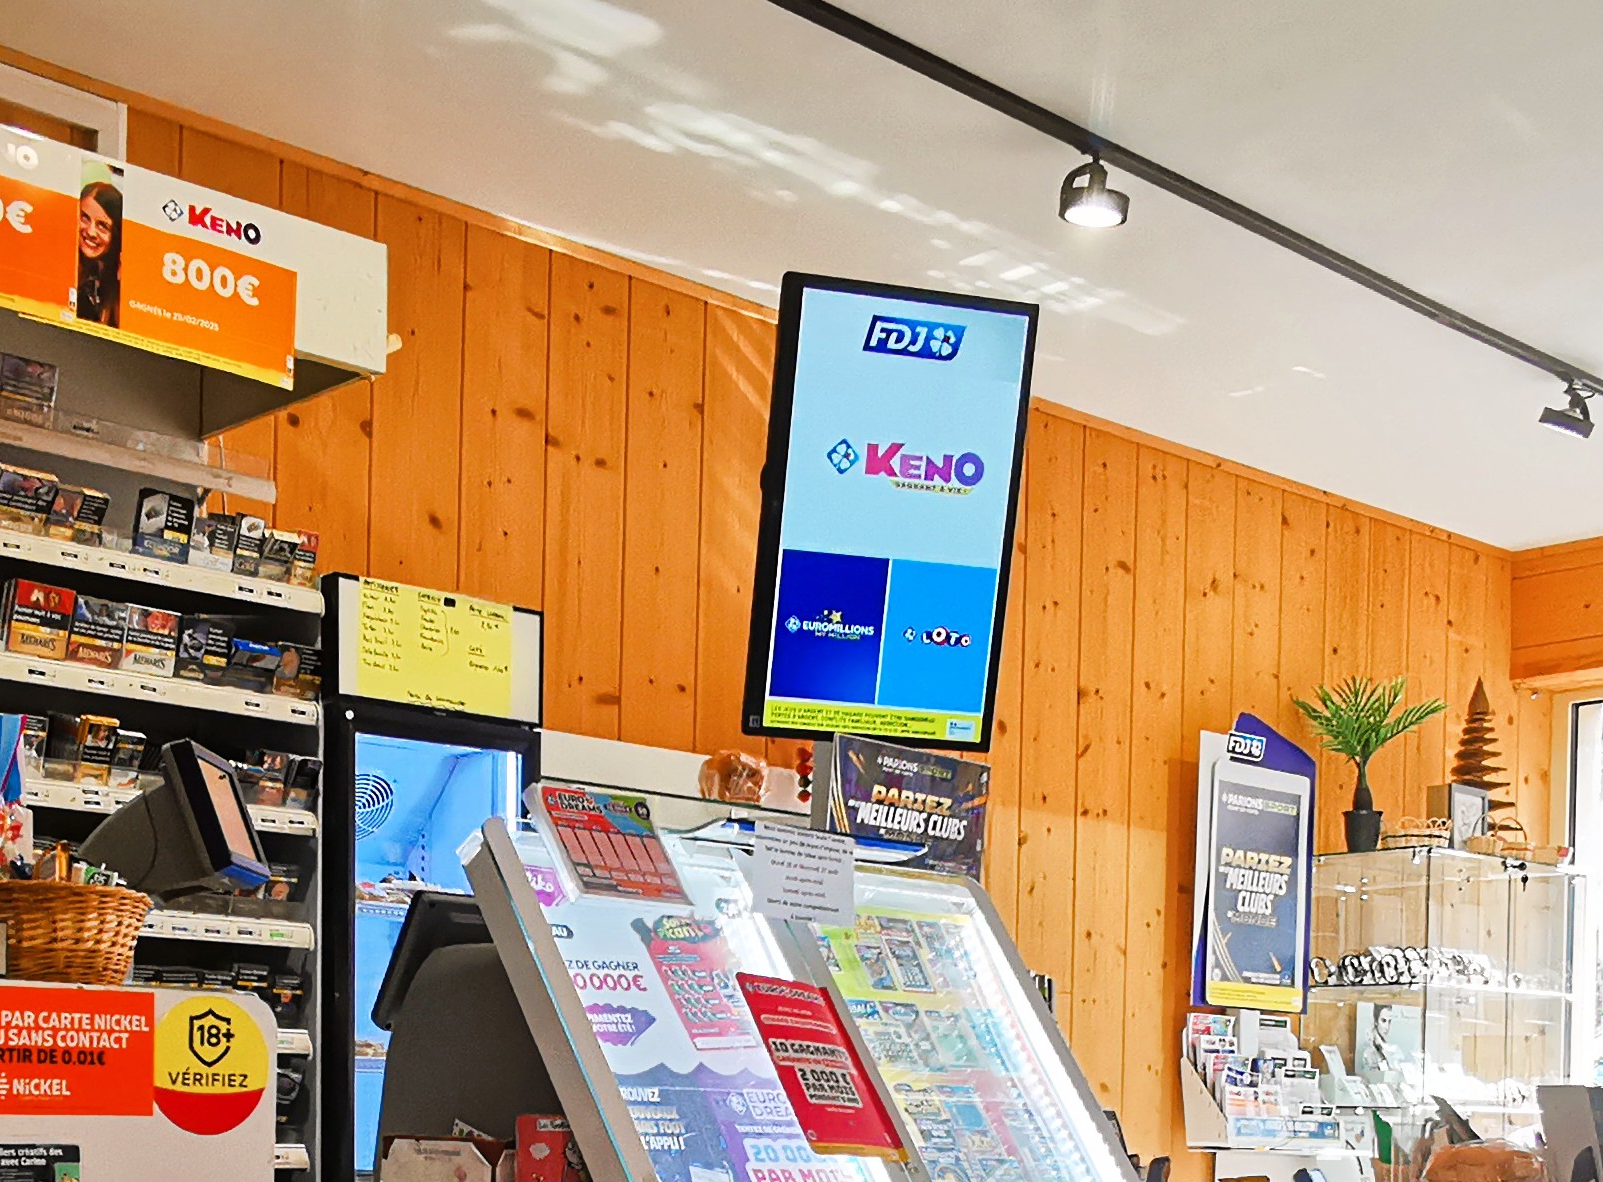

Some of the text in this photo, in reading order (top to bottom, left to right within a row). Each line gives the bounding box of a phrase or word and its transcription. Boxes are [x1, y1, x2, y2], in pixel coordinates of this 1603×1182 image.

[188, 204, 261, 245] KENO
[162, 252, 260, 306] 800€
[869, 322, 928, 352] FDJ
[865, 441, 985, 488] KENO
[803, 620, 875, 637] EUROMILLIONS
[921, 626, 973, 649] LOTO
[1230, 736, 1250, 752] FDJ
[883, 756, 919, 772] PARIONS
[871, 784, 953, 816] PARIEZ
[1228, 792, 1263, 809] PARIONS
[856, 801, 968, 841] MEILLEURS CLUBS
[1221, 848, 1292, 870] PARIEZ
[1226, 866, 1289, 896] MEILLEURS
[1237, 891, 1274, 915] CLUBS
[576, 960, 639, 972] DE GAGNER
[1, 1010, 35, 1027] PAR
[37, 1012, 92, 1029] CARTE
[94, 1014, 150, 1032] NICKEL
[8, 1030, 53, 1046] SANS
[55, 1031, 129, 1049] CONTACT
[196, 1023, 235, 1046] 18+
[36, 1048, 58, 1065] DE
[61, 1050, 106, 1066] 0.01€
[771, 1040, 789, 1053] 10
[168, 1067, 248, 1088] VÉRIFIEZ
[799, 1069, 839, 1084] 2 000
[805, 1082, 856, 1097] PAR MOIS
[750, 1144, 780, 1164] 20
